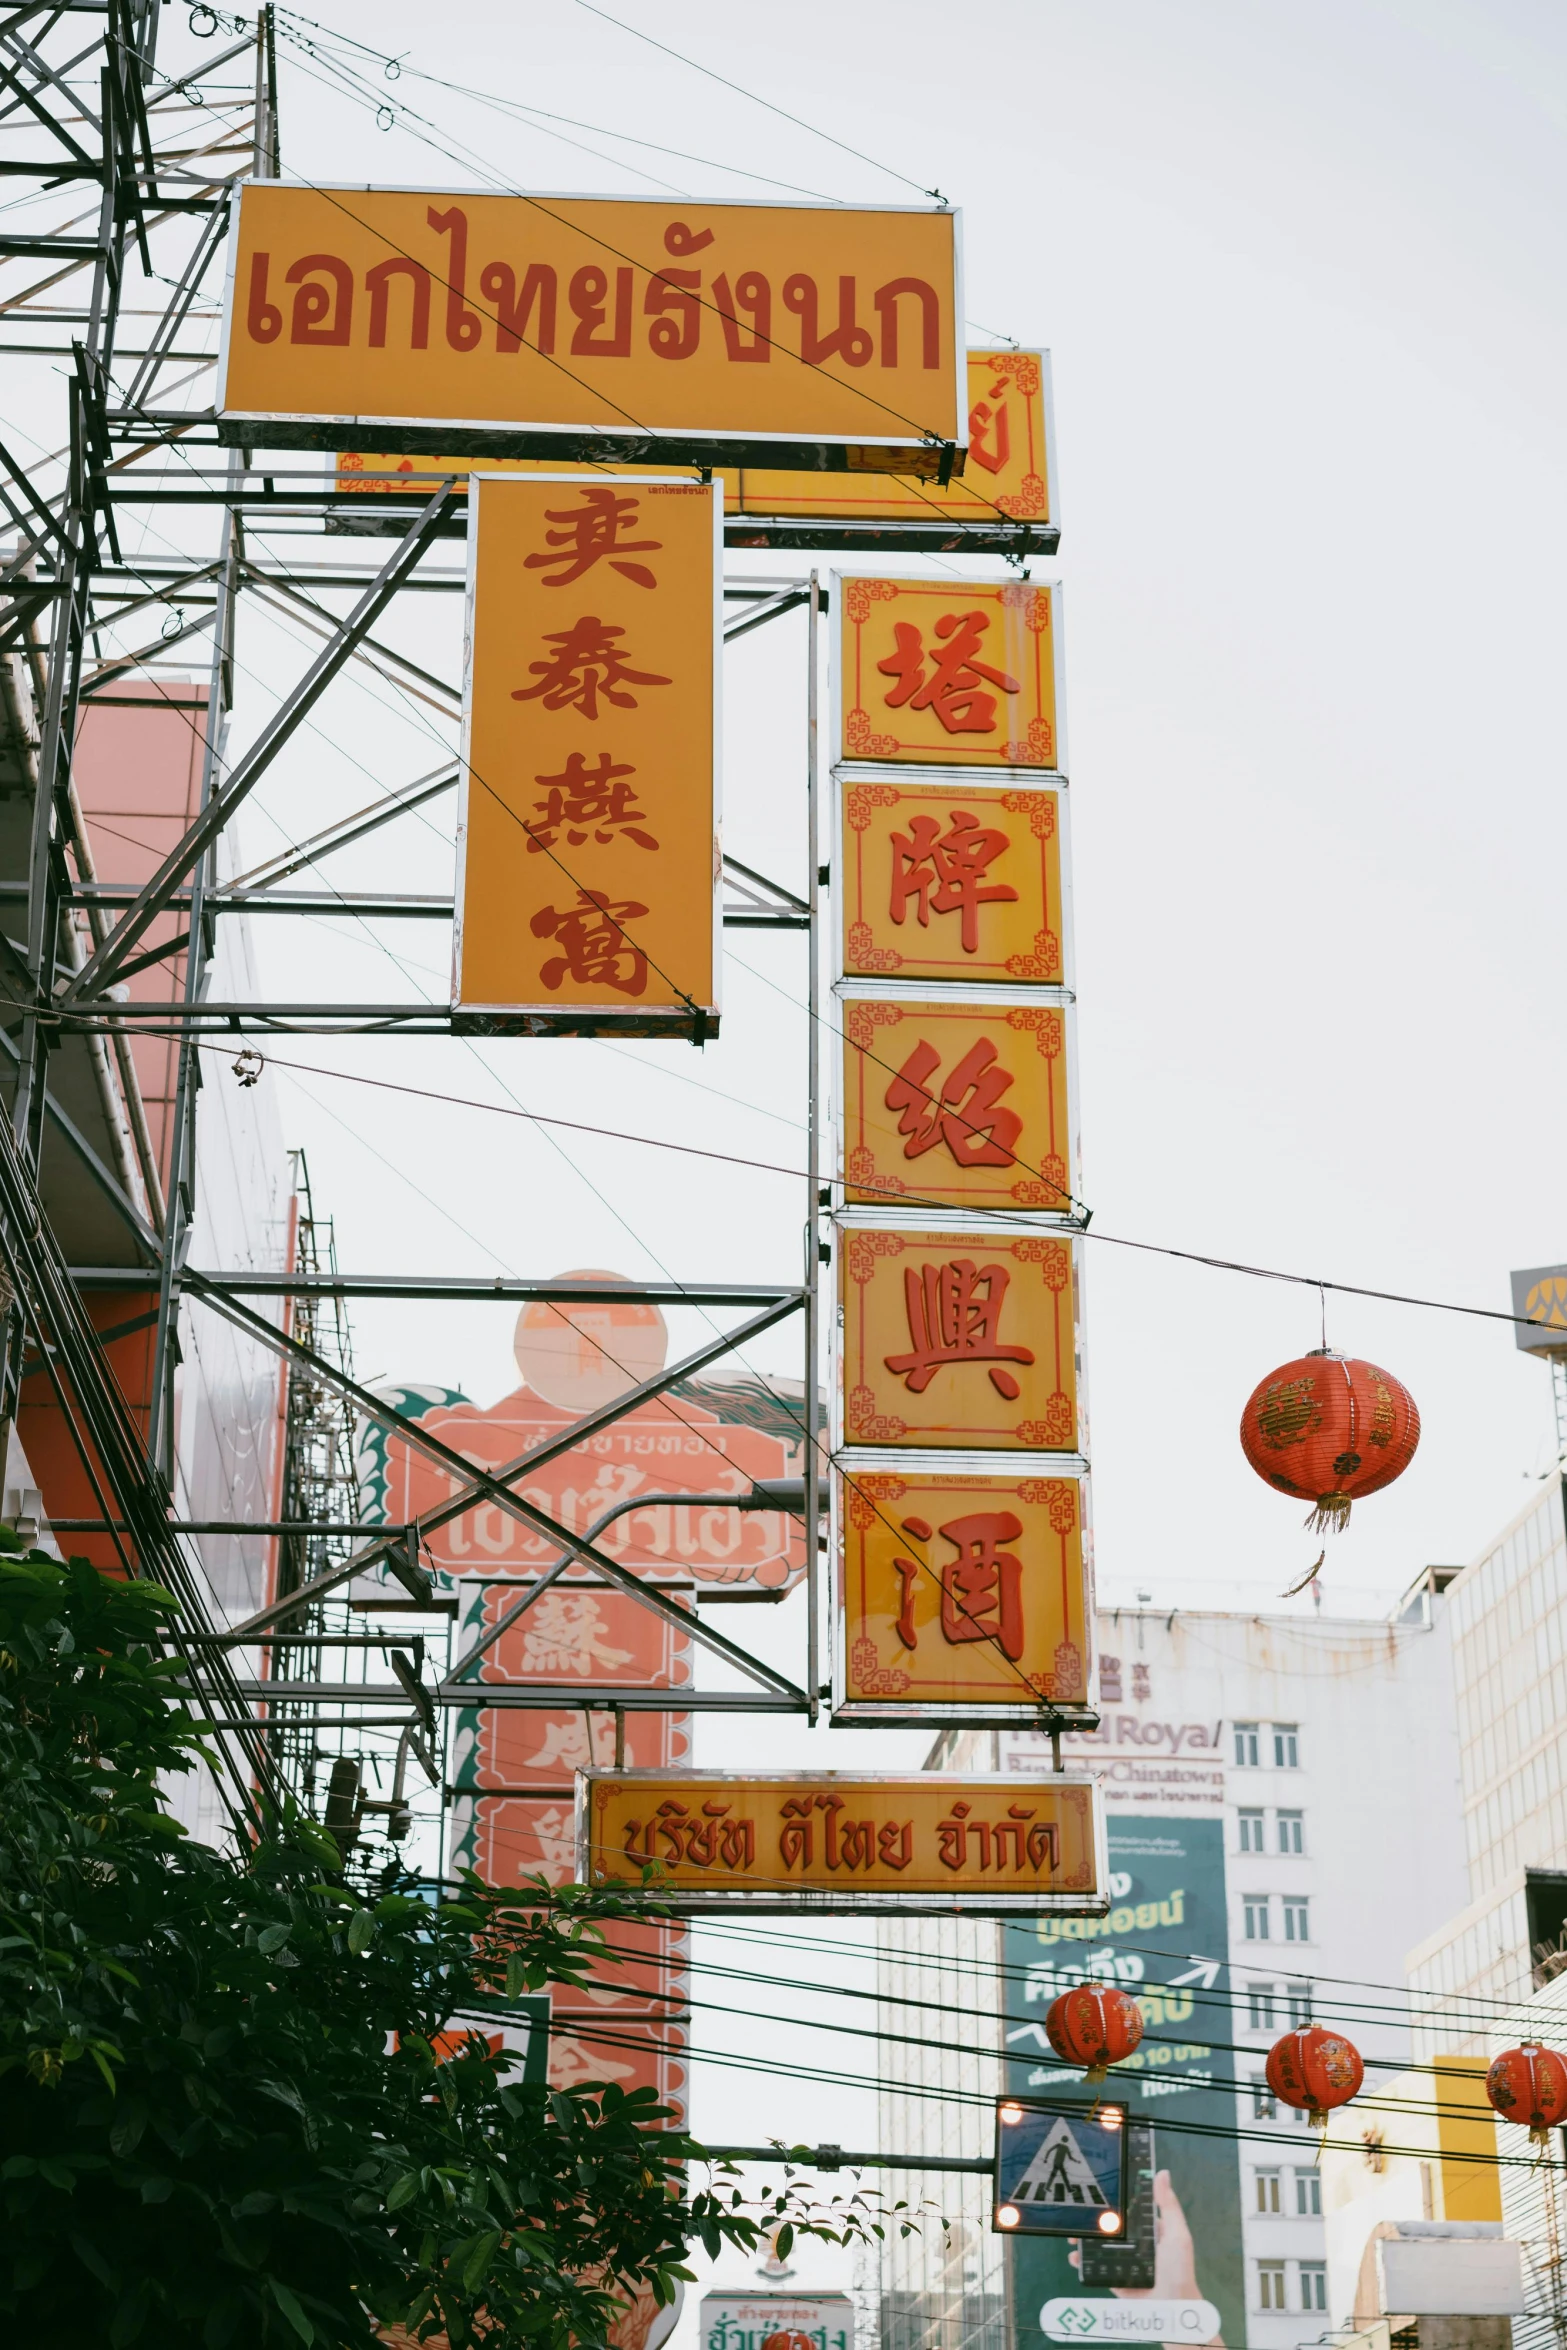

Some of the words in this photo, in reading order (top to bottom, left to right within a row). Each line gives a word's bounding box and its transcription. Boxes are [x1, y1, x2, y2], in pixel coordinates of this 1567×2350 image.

[246, 205, 942, 370] เอกไทยรังนก
[522, 1427, 728, 1456] ห้งขายทอง
[1115, 1714, 1222, 1754] Royal
[623, 1799, 755, 1870] บริษัท
[780, 1792, 914, 1872] ดีไทย
[935, 1800, 1060, 1873] จำกัด
[1103, 2309, 1164, 2332] bitkub
